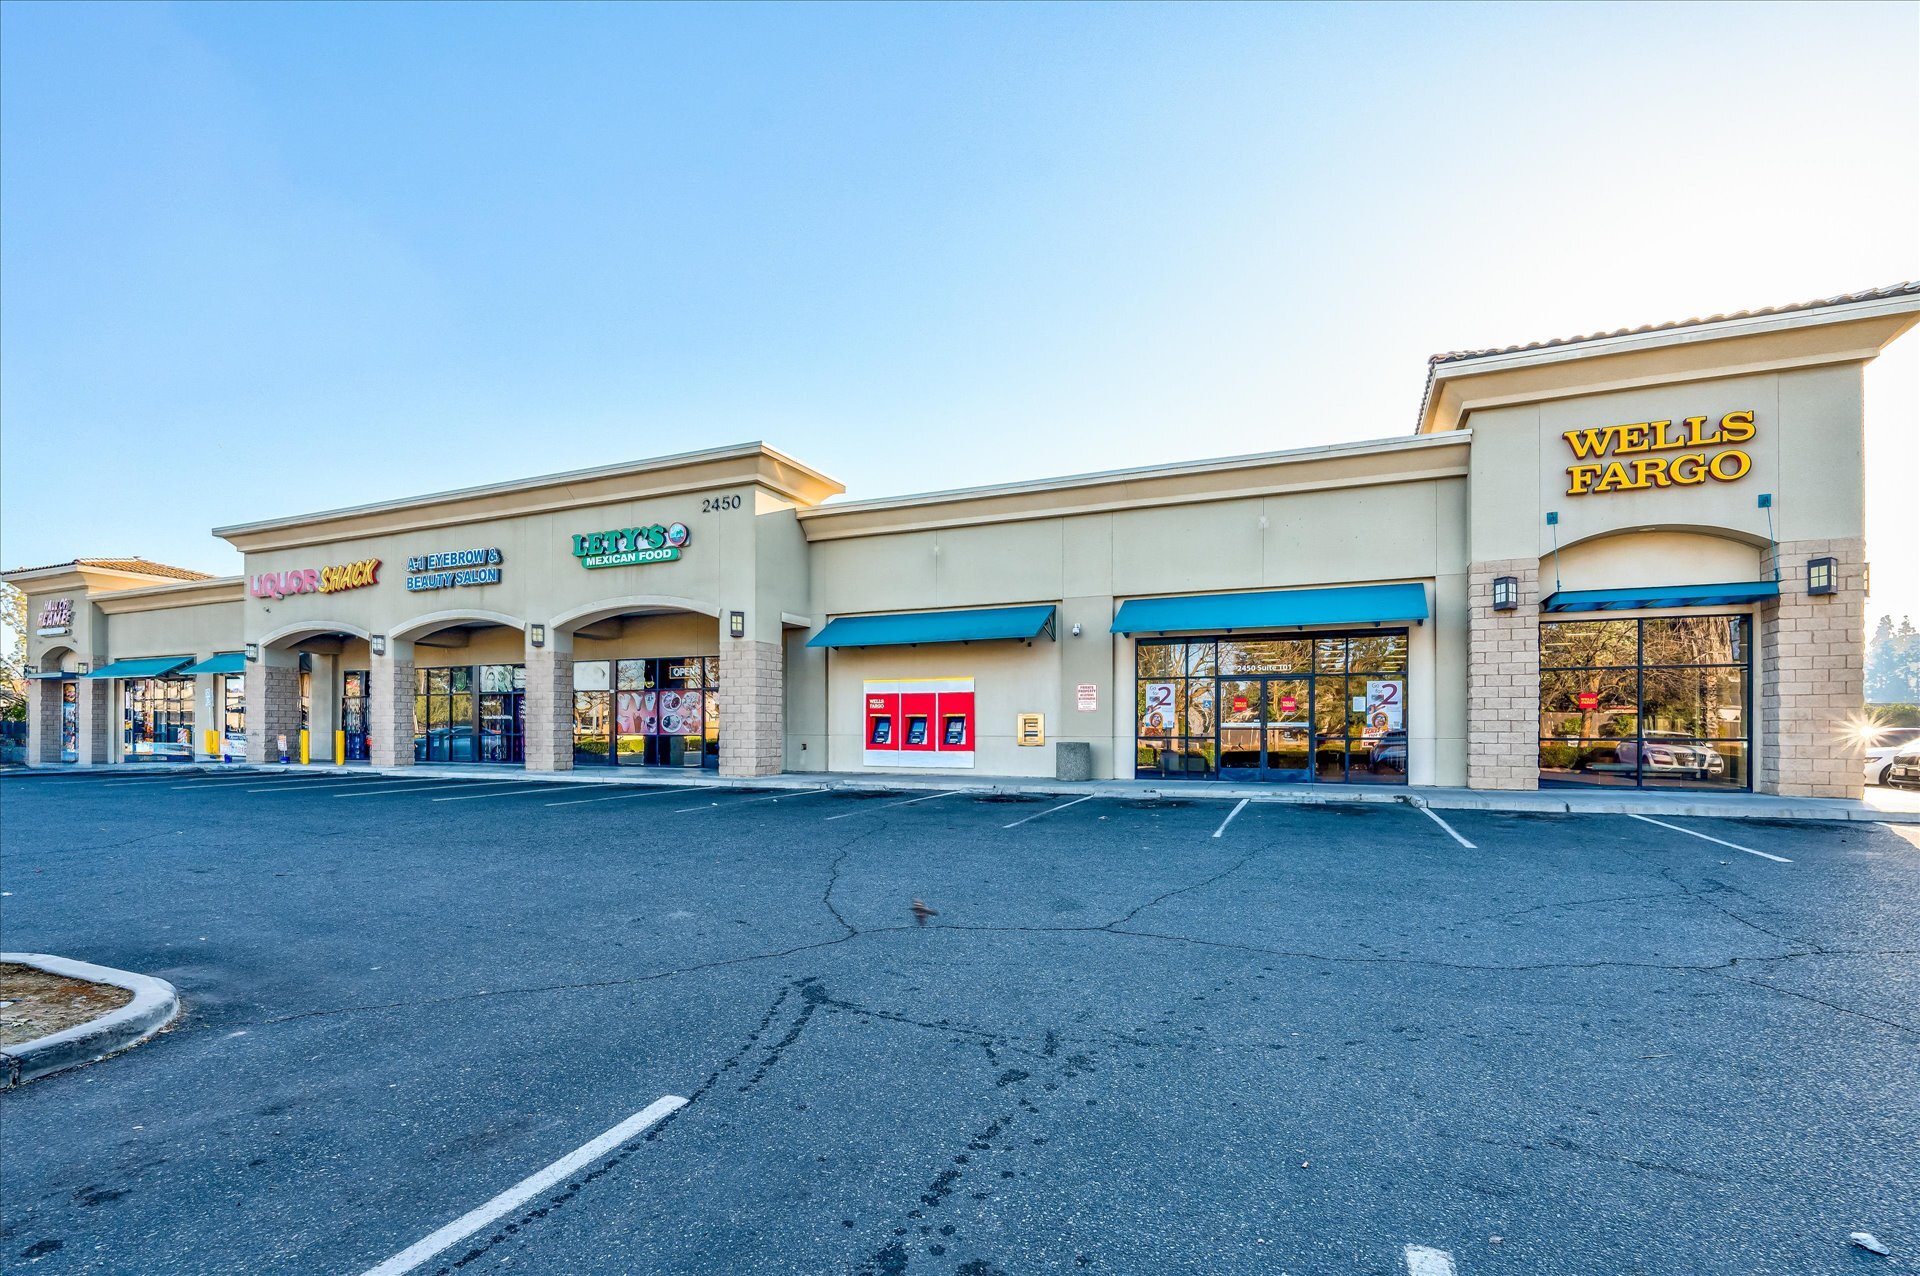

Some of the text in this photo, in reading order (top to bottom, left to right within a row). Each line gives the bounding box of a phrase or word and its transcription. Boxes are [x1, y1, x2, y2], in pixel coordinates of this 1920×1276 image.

[1562, 410, 1756, 460] WELLS
[1566, 450, 1752, 496] FARGO
[702, 495, 741, 513] 2450
[572, 524, 668, 557] LETY'S
[407, 547, 503, 572] A-1 EYEBROW &
[586, 549, 672, 566] MEXICAN FOOD
[250, 558, 382, 600] LIQUOR SHACK
[406, 567, 498, 592] BEAUTY SALON
[672, 667, 695, 677] OPEN
[1237, 664, 1256, 672] 2450
[1157, 686, 1171, 706] 2
[1380, 683, 1398, 705] 2
